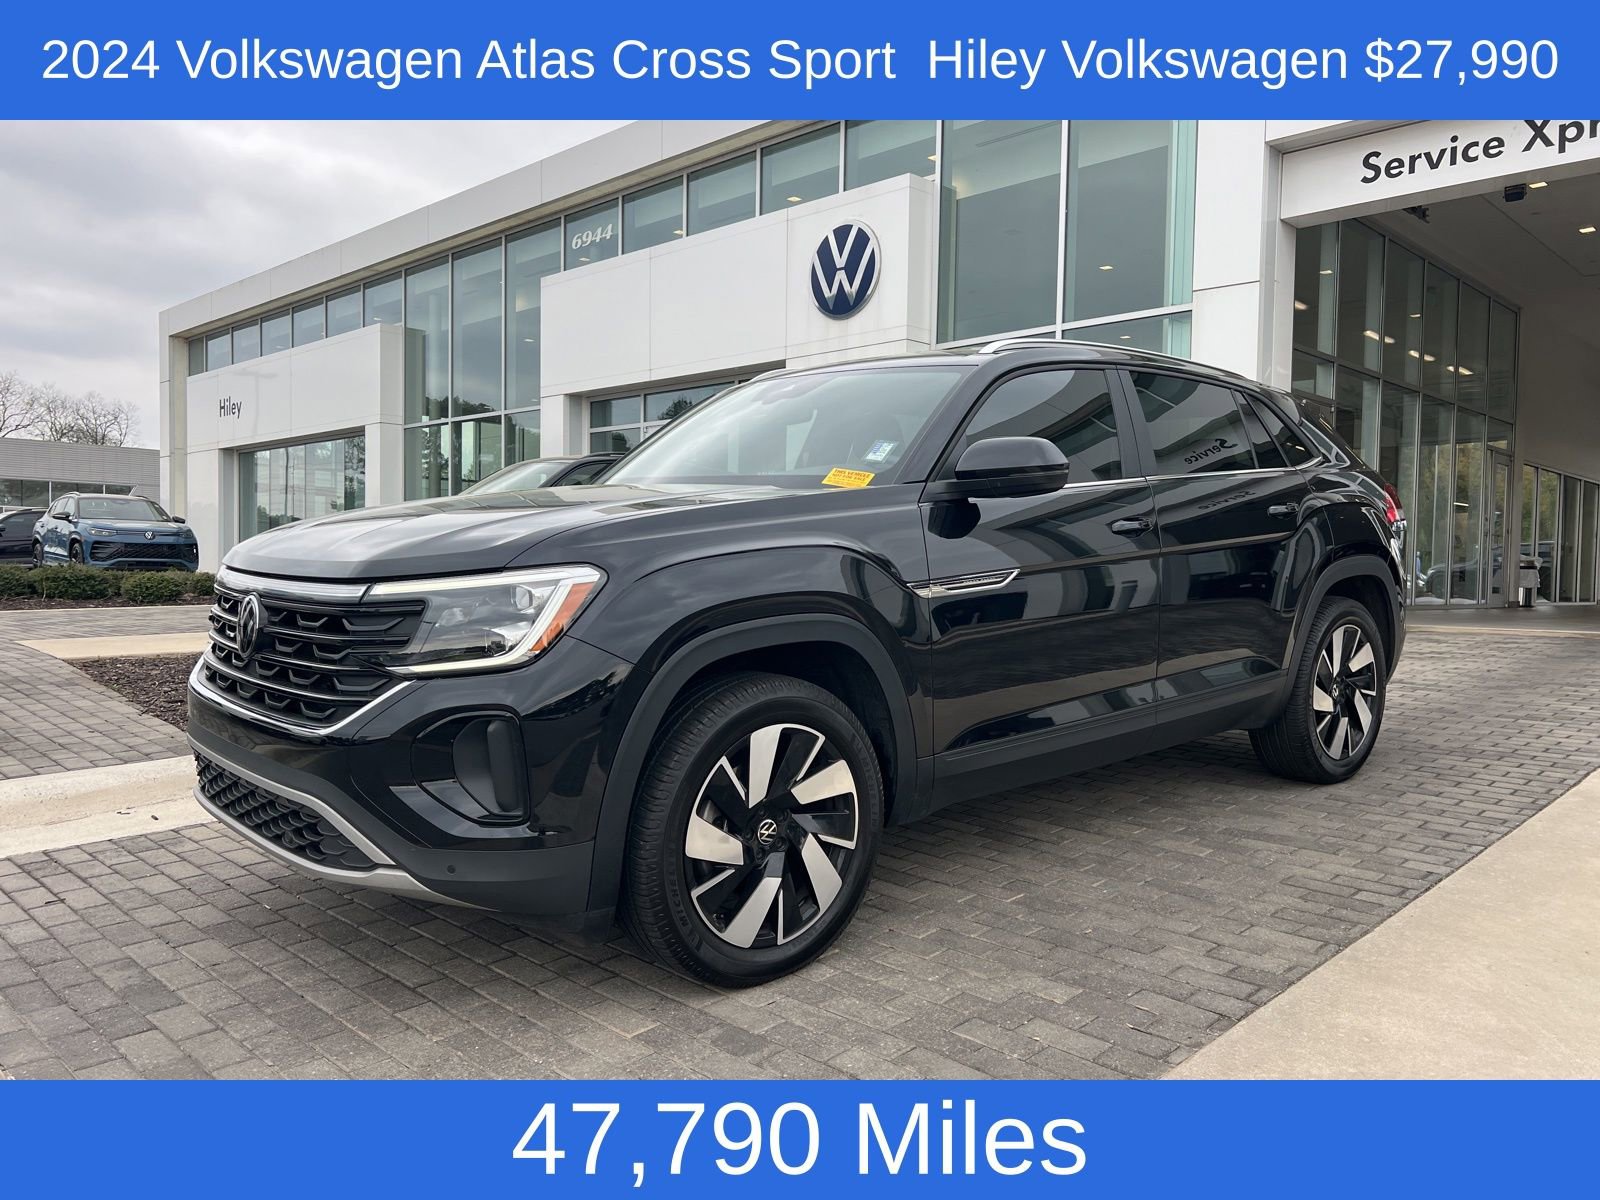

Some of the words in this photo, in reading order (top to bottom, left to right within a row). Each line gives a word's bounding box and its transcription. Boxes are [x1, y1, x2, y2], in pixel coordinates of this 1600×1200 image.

[1360, 134, 1505, 184] Service
[571, 223, 613, 250] 6944
[219, 396, 242, 420] Hiley
